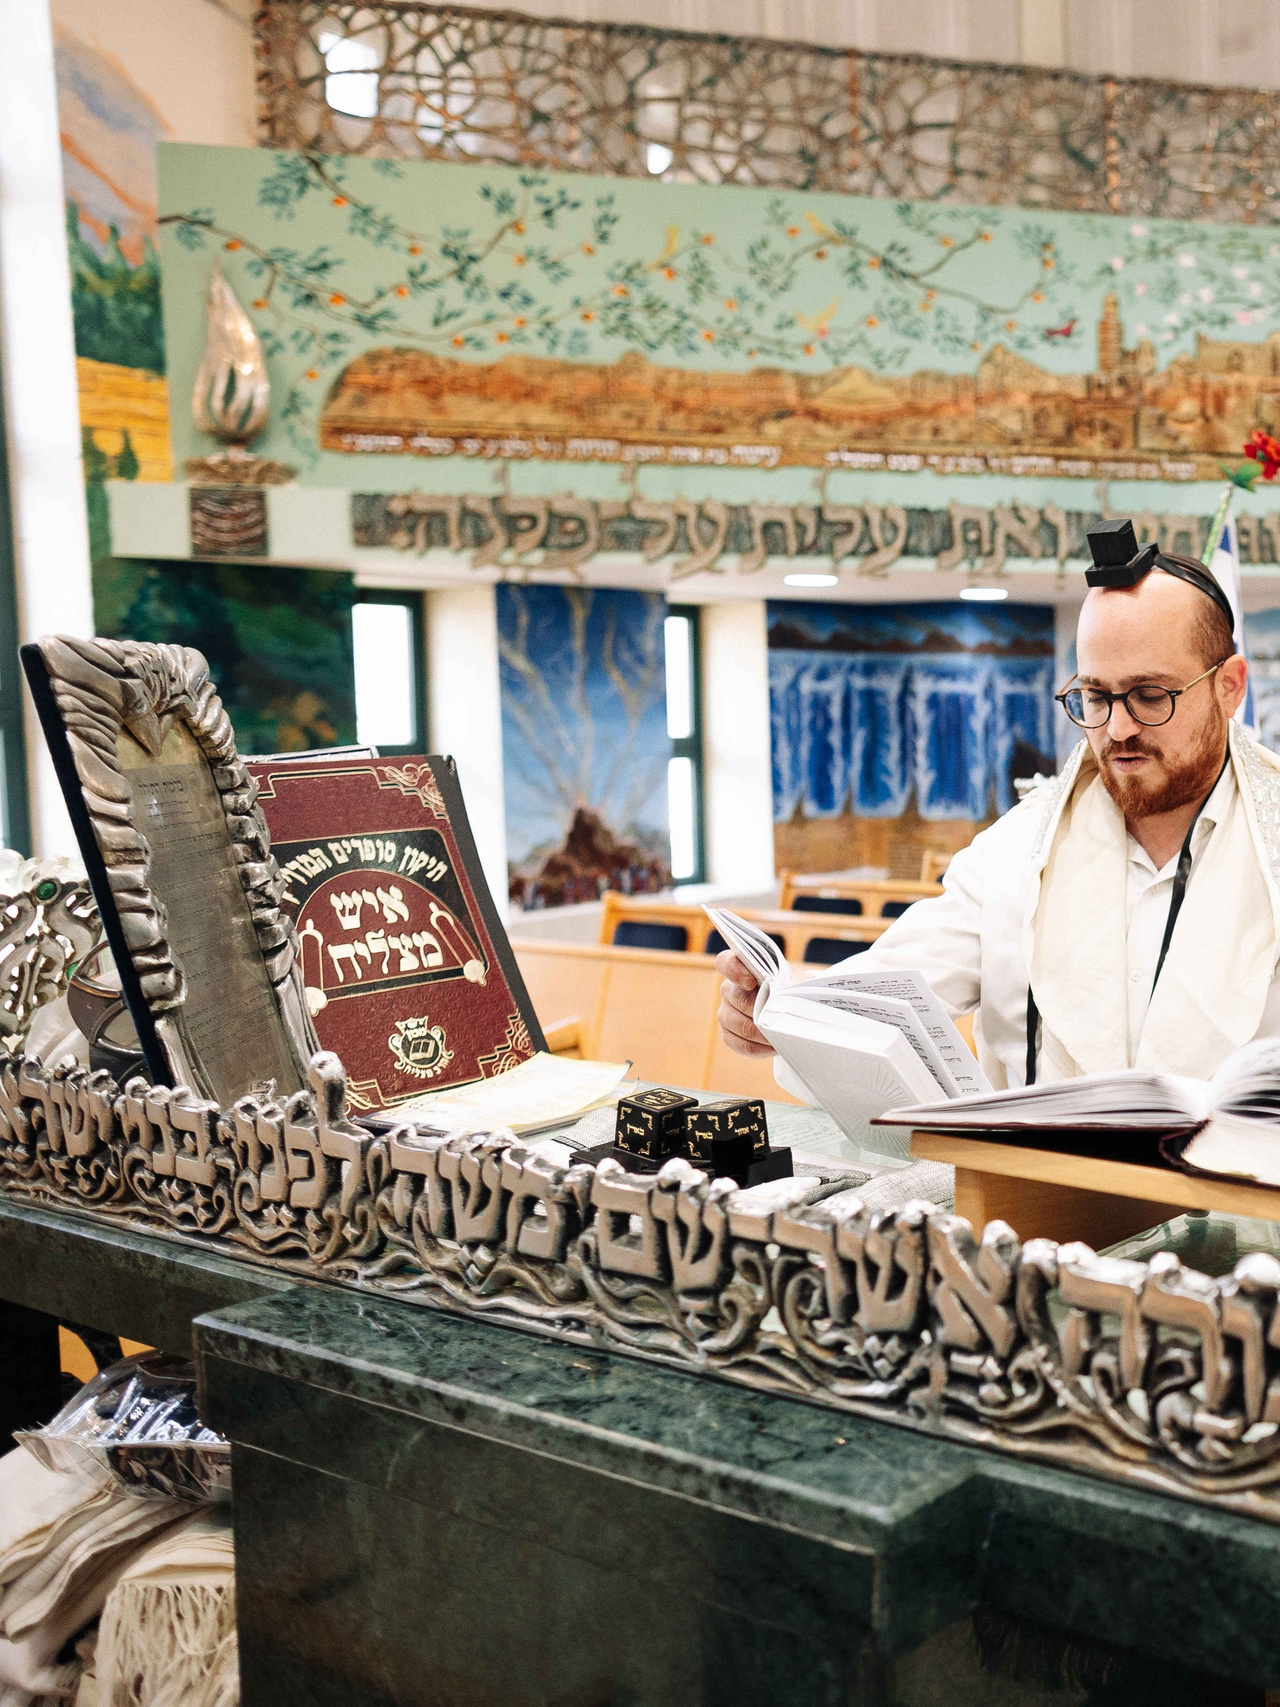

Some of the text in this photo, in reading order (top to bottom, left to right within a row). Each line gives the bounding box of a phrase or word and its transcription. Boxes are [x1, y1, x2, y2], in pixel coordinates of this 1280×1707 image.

[327, 837, 397, 865] סופרים
[398, 845, 449, 883] תיקון
[329, 884, 410, 930] איש
[327, 928, 444, 983] מצליח
[403, 1065, 434, 1079] מצליח
